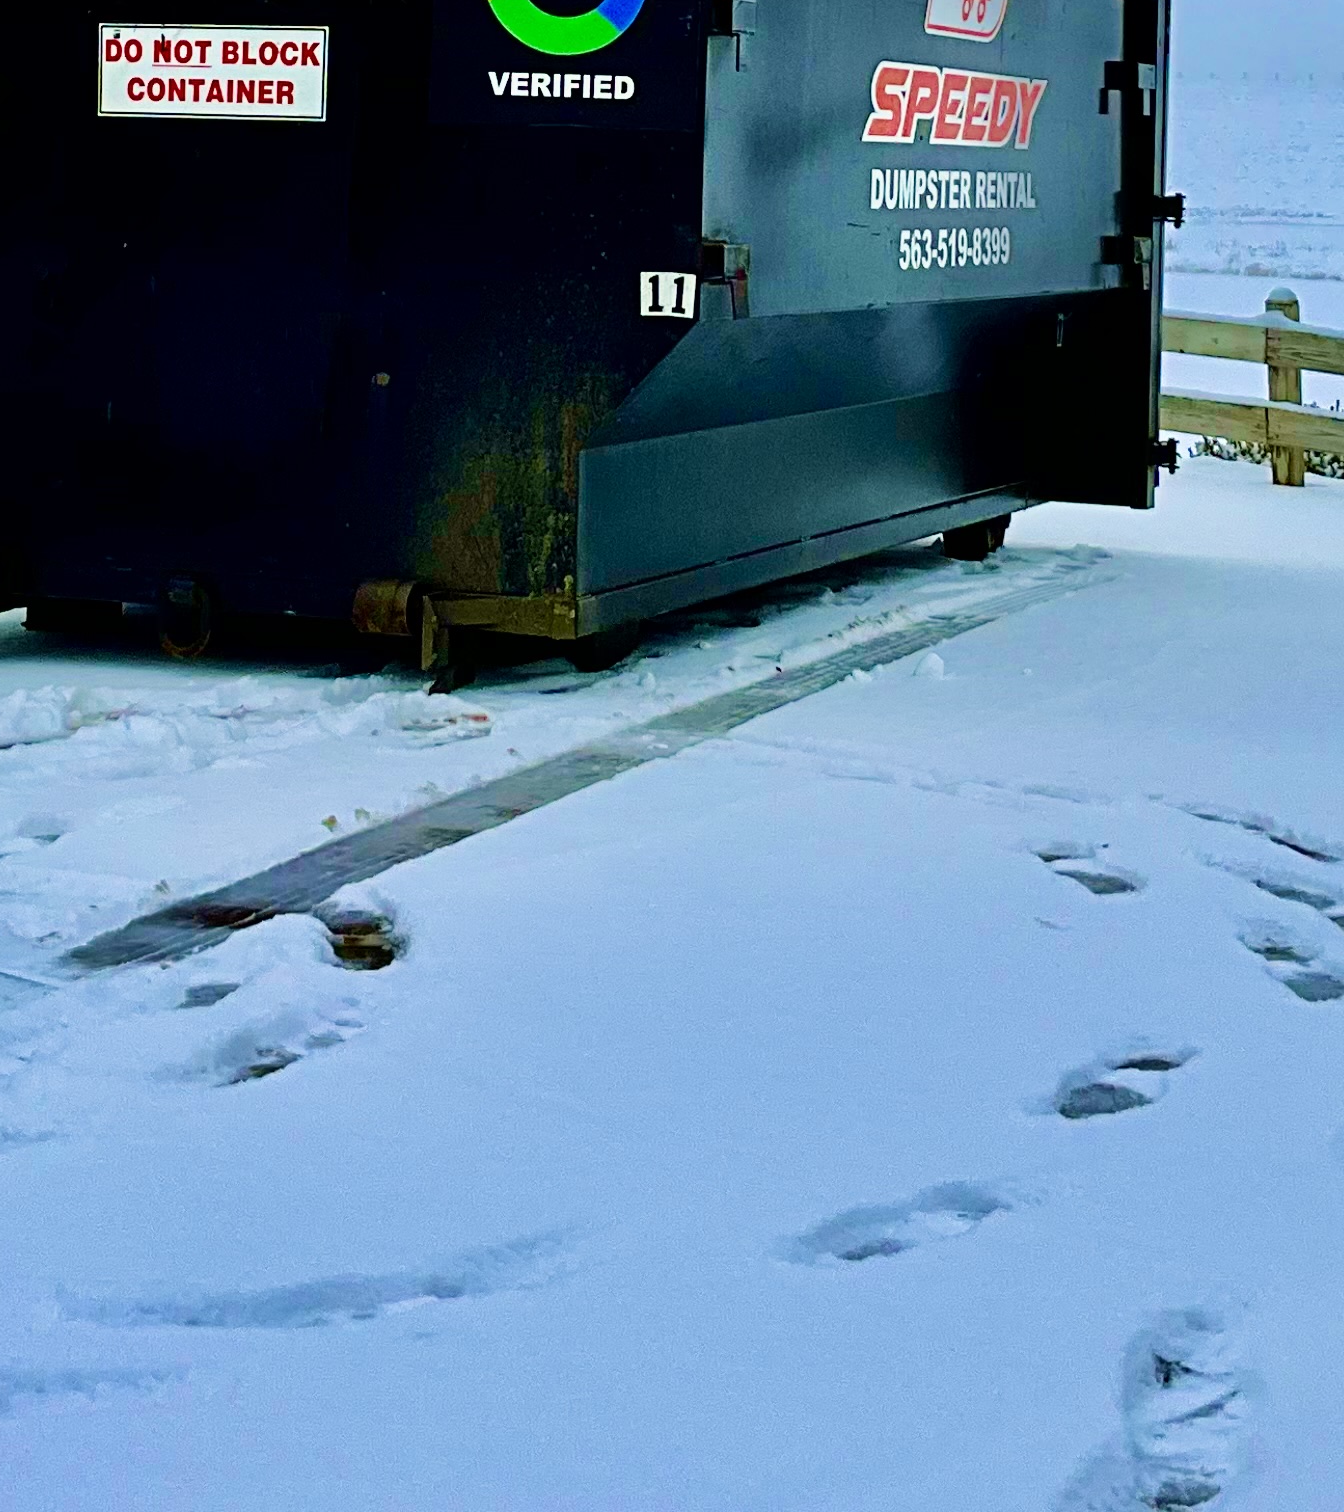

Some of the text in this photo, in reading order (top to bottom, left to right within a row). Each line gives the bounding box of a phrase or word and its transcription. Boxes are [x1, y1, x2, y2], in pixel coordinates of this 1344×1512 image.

[105, 38, 321, 67] DO NOT BLOCK
[127, 77, 295, 105] CONTAINER
[488, 71, 636, 100] VERIFIED
[862, 60, 1048, 149] SPEEDY
[870, 168, 1037, 210] DUMPSTER RENTAL
[898, 226, 1011, 270] 563-519-8399
[648, 274, 686, 315] 11
